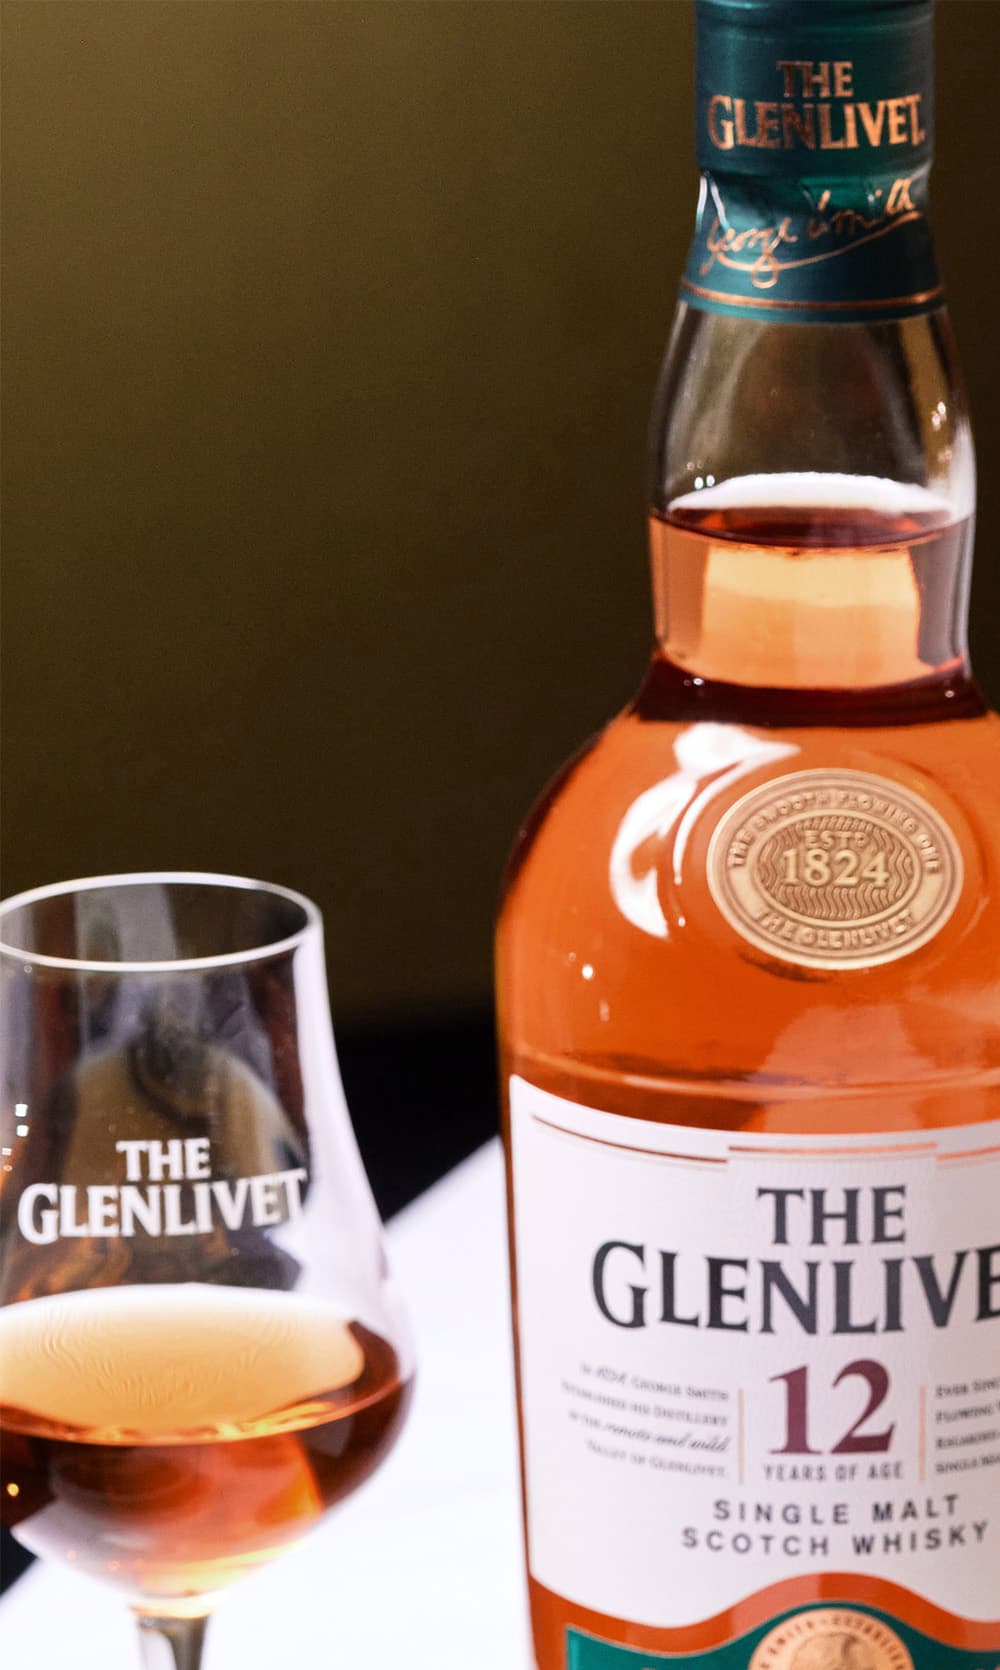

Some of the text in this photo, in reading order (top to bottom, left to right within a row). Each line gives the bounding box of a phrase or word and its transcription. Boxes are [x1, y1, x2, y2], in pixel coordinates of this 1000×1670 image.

[776, 60, 854, 98] THE
[783, 848, 891, 888] 1824
[115, 1138, 212, 1182] THE
[17, 1168, 307, 1246] GLENLIVET
[756, 1184, 906, 1246] THE
[769, 1357, 896, 1455] 12
[763, 1461, 903, 1482] YEARS OF AGE
[713, 1493, 959, 1526] SINGLE MALT
[682, 1519, 988, 1557] SCOTCH WHISKY
